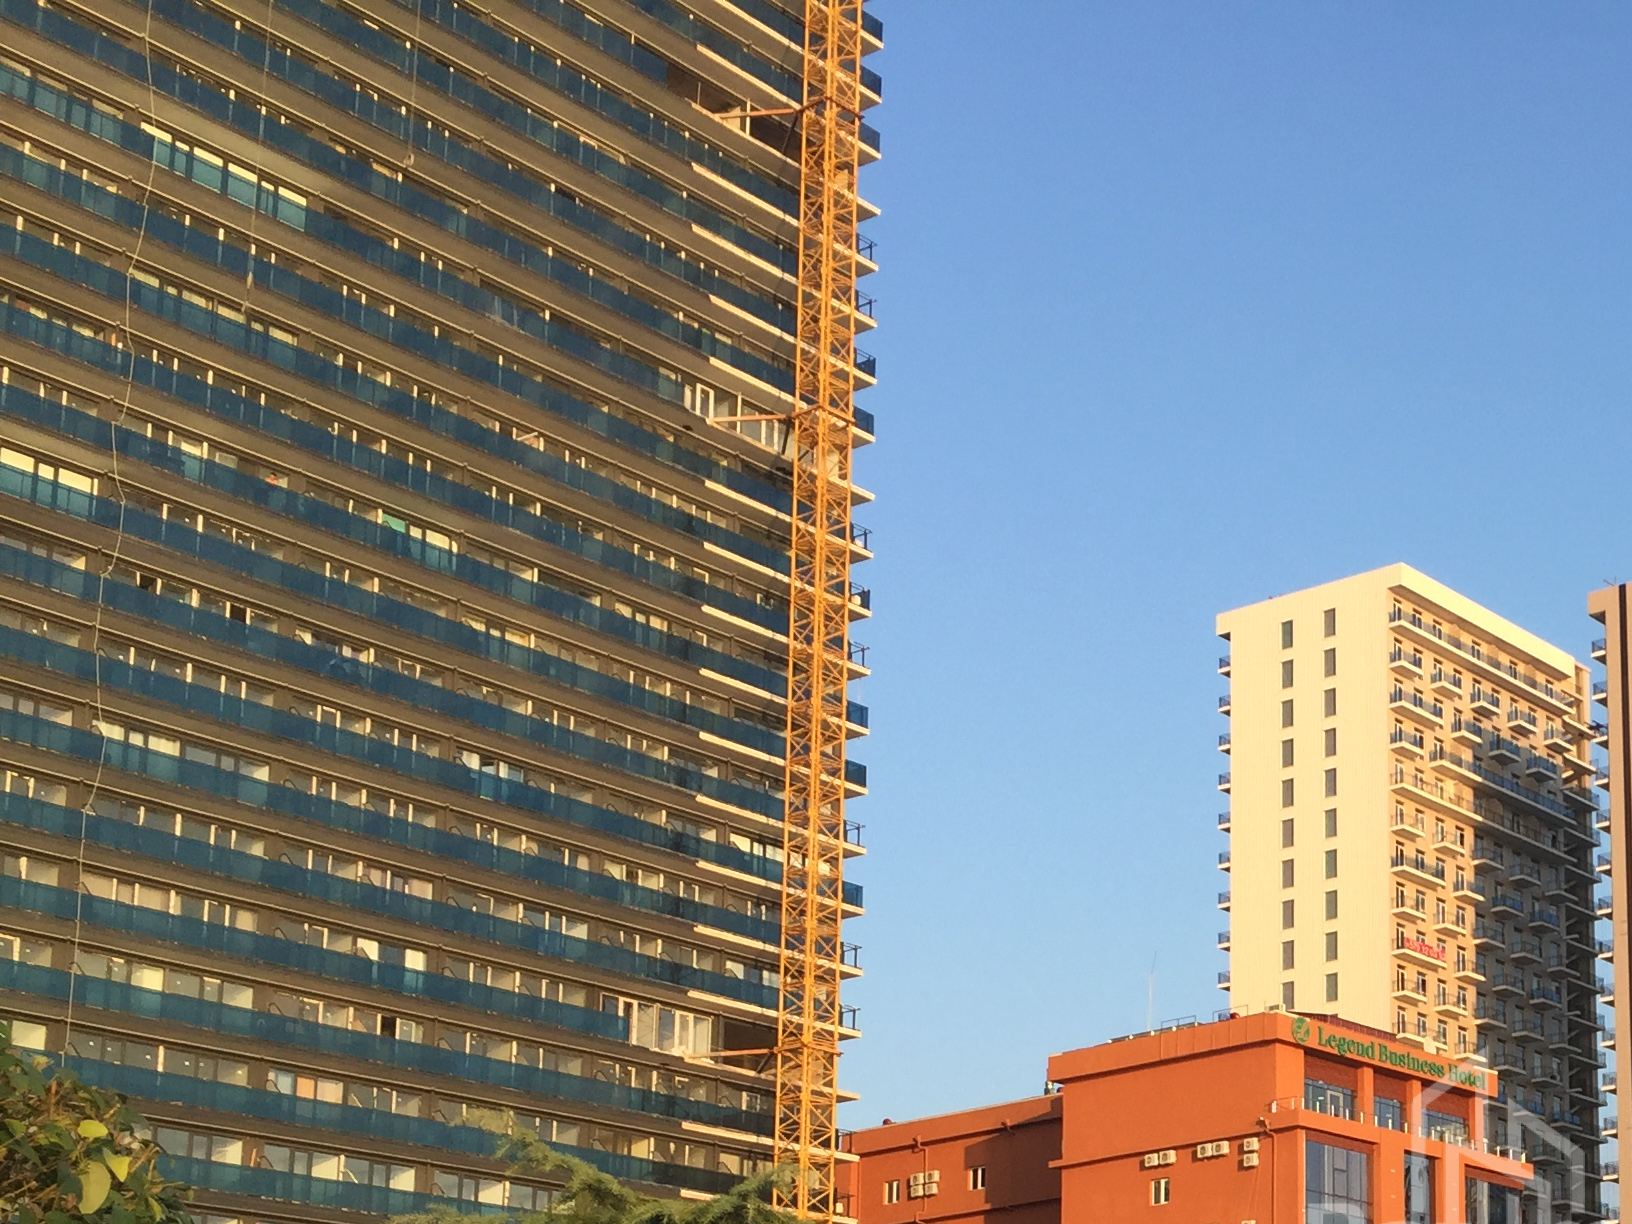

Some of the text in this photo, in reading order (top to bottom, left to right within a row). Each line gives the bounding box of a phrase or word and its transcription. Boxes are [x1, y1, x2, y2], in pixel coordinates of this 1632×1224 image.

[1317, 1025, 1487, 1090] Legend Business Hotel
